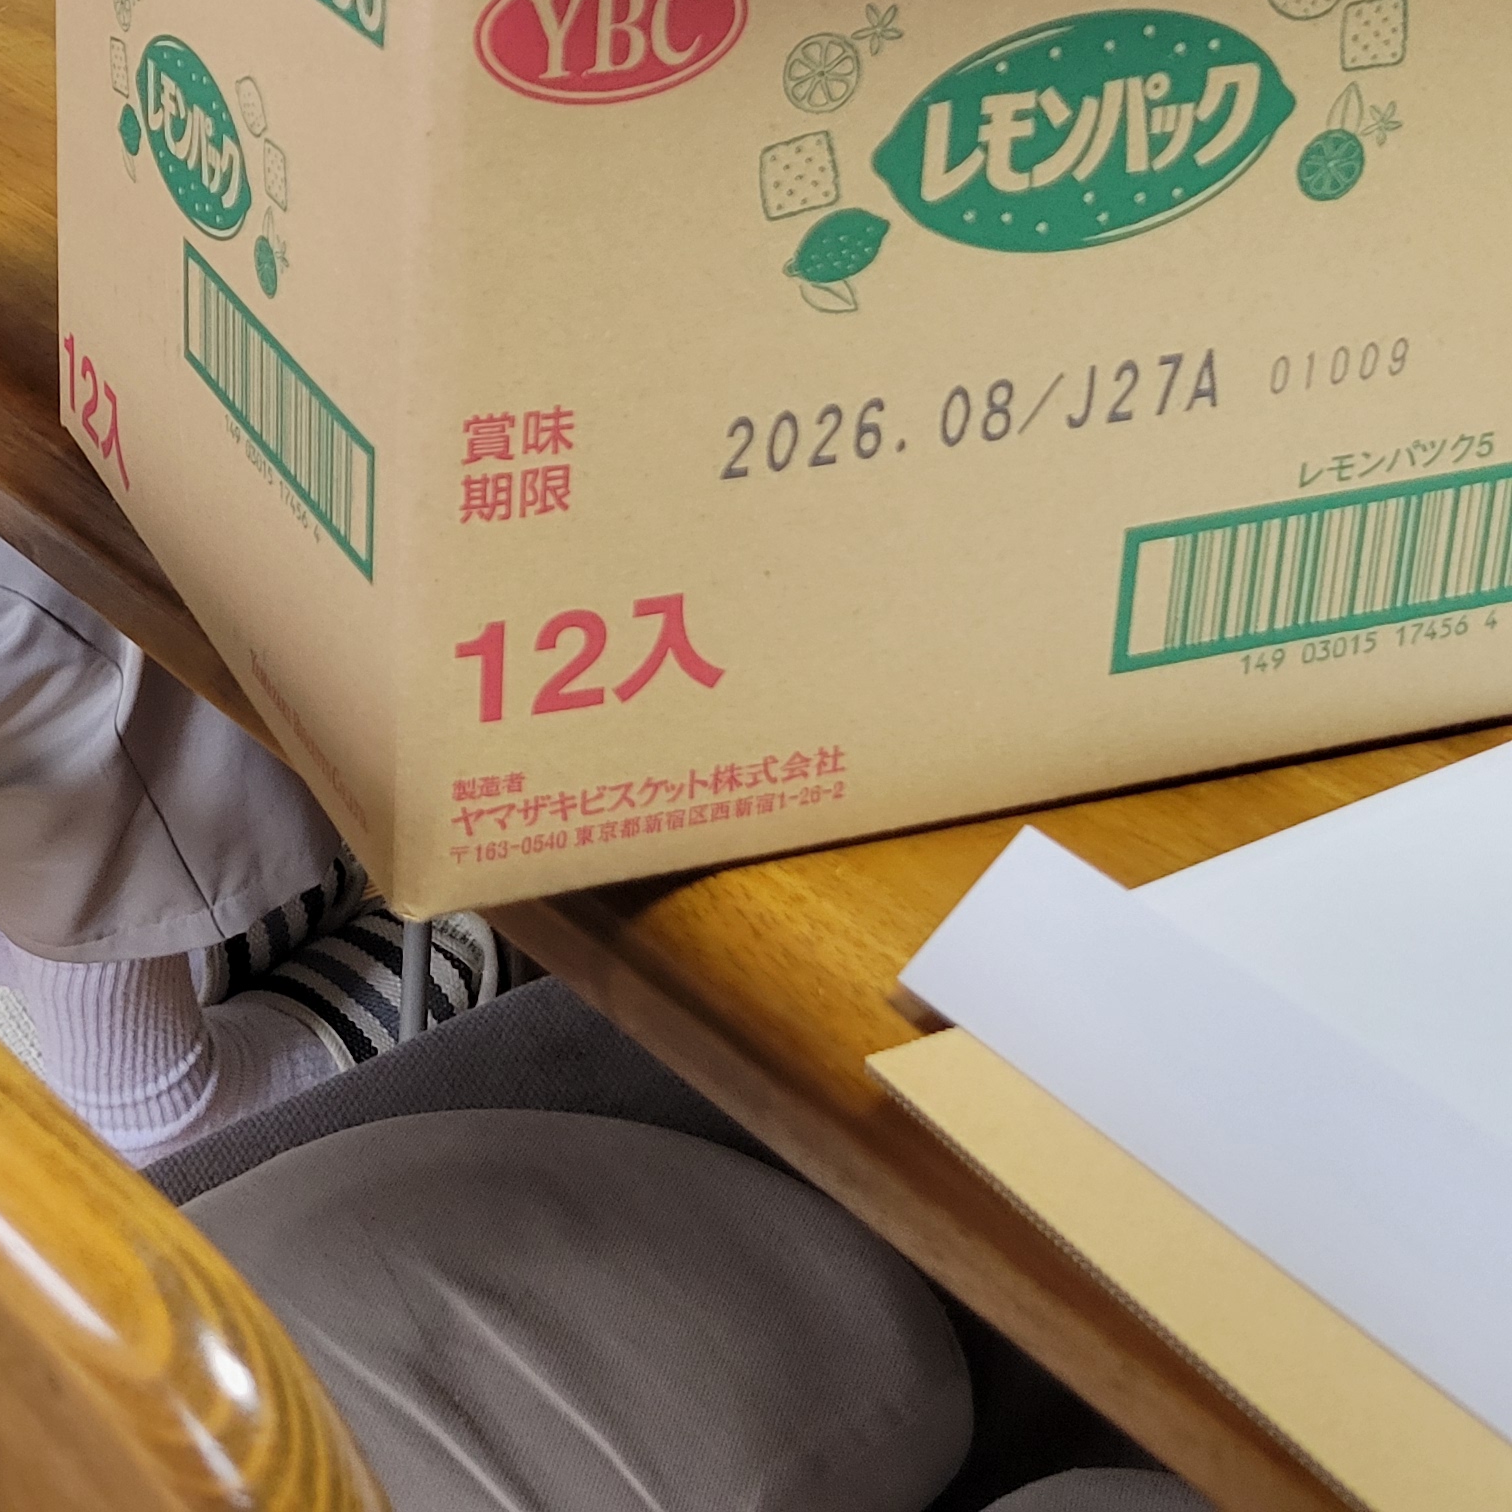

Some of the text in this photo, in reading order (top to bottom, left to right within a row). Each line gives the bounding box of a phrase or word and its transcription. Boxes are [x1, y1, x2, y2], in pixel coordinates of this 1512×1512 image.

[146, 58, 239, 209] レモンパック
[920, 62, 1261, 202] レモンパック
[1269, 336, 1410, 395] 01009
[64, 331, 130, 492] 12入
[462, 404, 576, 465] 賞味
[459, 463, 572, 524] 期限
[454, 592, 727, 724] 12入
[1240, 610, 1498, 675] 149 03015 17456 4
[450, 745, 847, 838] ヤマザキビスケット株式会社
[451, 771, 526, 802] 製造者
